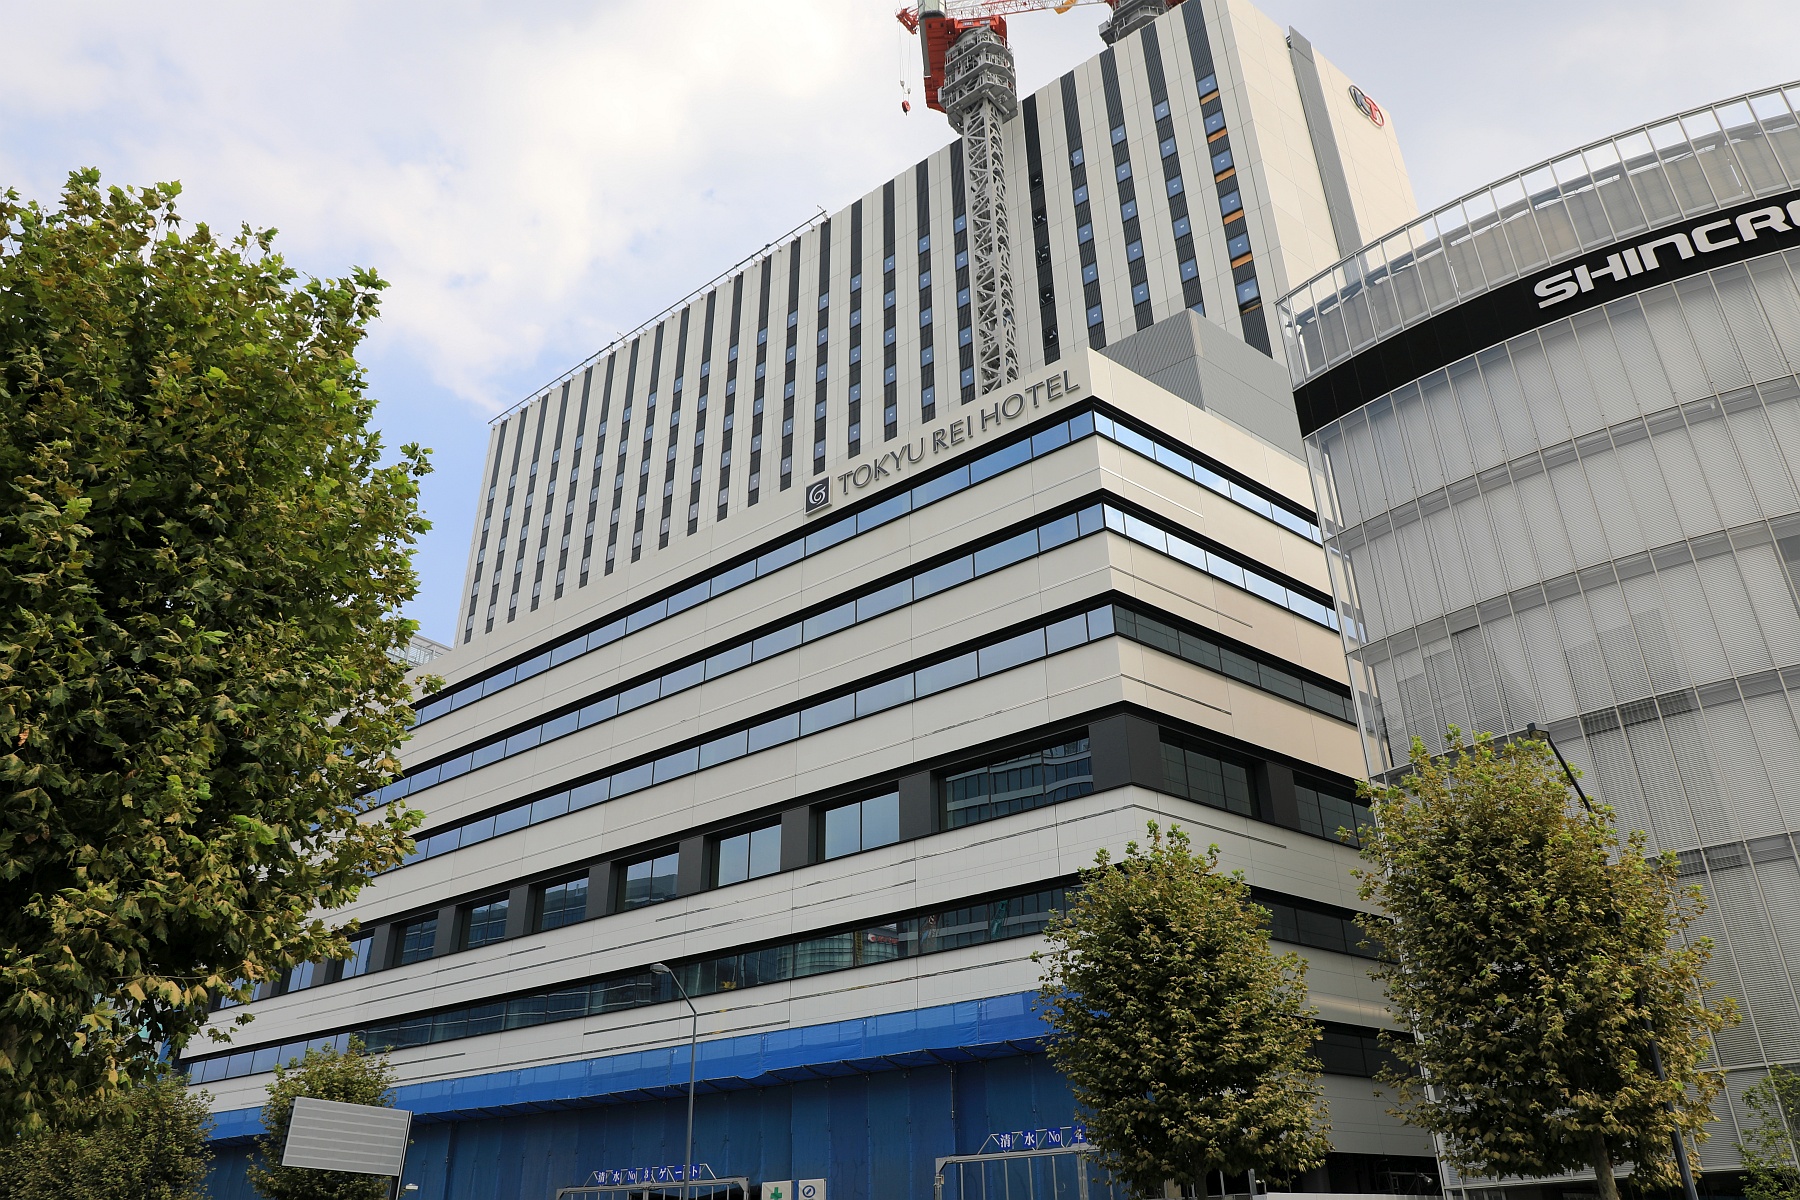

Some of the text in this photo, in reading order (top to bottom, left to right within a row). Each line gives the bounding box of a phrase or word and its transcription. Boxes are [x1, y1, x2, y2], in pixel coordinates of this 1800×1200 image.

[1533, 199, 1800, 309] SHINCR
[837, 370, 1081, 495] TOKYU REI HOTEL
